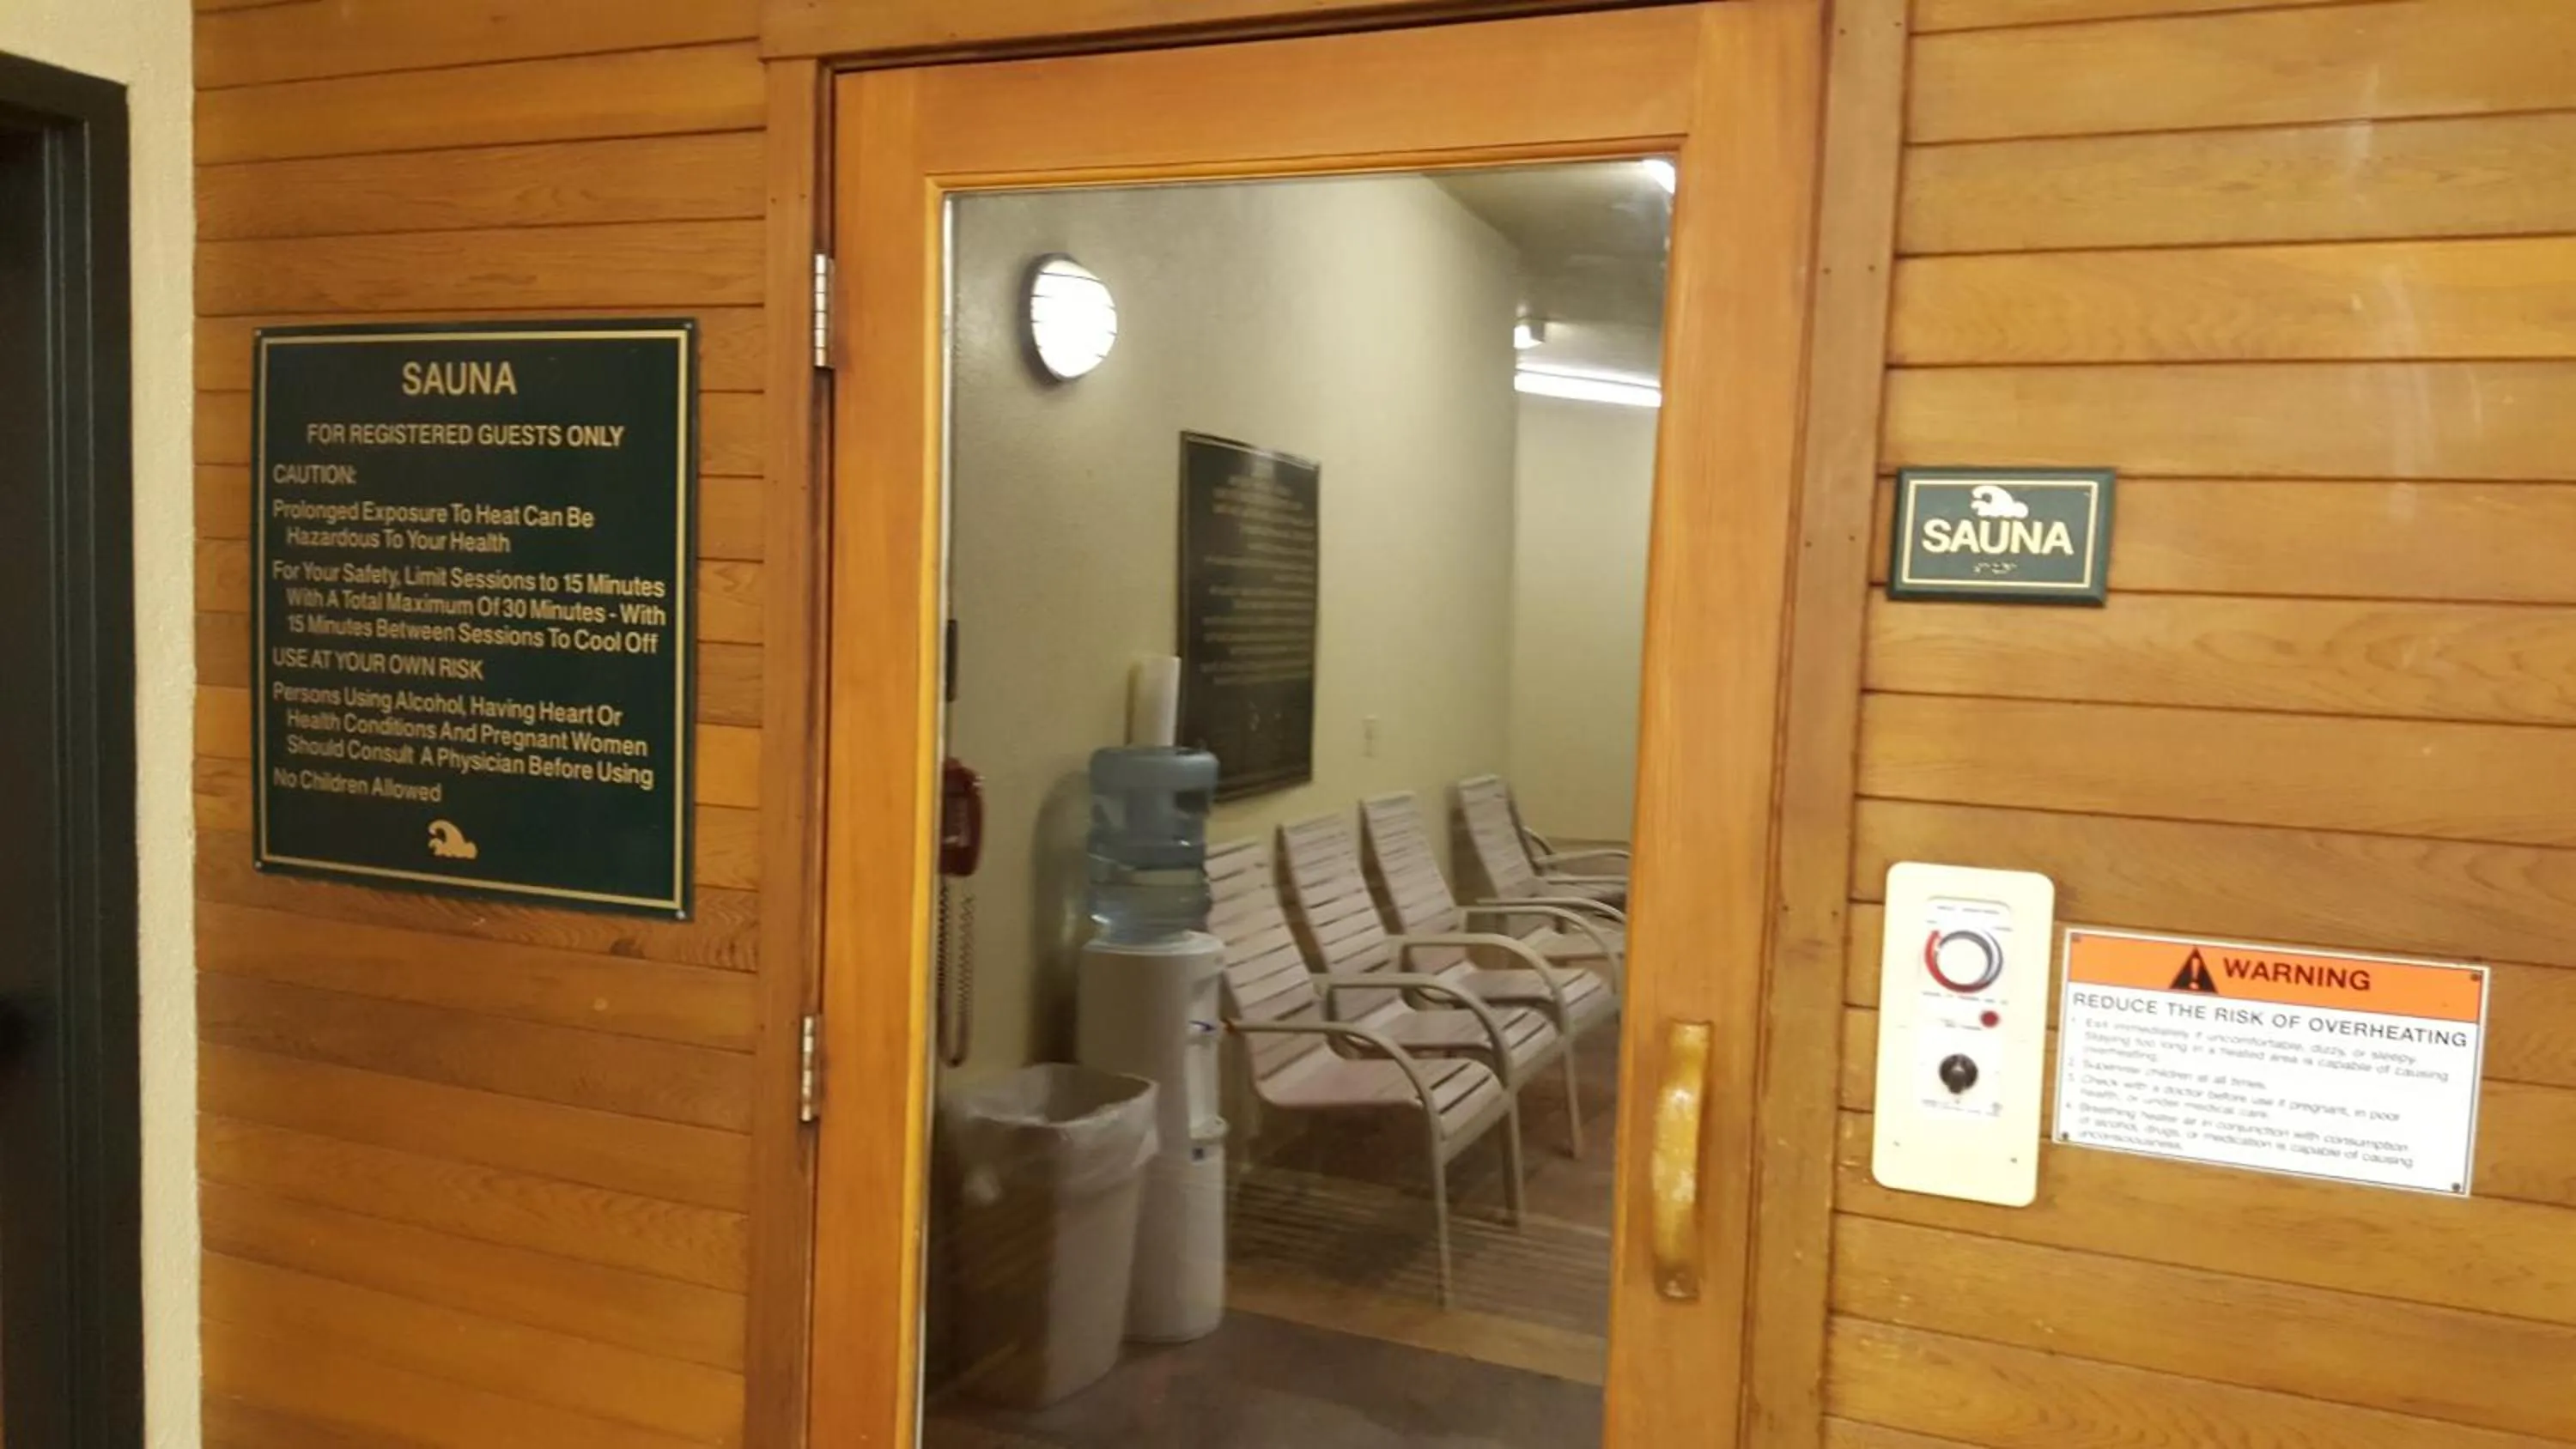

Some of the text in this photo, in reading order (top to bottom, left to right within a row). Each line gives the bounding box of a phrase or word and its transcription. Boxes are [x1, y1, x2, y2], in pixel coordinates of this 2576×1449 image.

[402, 361, 517, 396] SAUNA
[307, 423, 624, 446] FOR REGISTERED GUESTS ONLY
[273, 464, 357, 484] CAUTION:
[273, 499, 594, 528] Prolonged Exposure To Heat Can Be
[287, 526, 511, 553] Hazardous To Your Health
[1922, 518, 2074, 555] SAUNA
[272, 561, 665, 597] For Your Safety, Limit Sessions to 15 Minutes
[286, 587, 324, 607] With
[326, 590, 339, 608] A
[342, 591, 383, 609] Total
[387, 591, 473, 615] Maximum
[477, 596, 501, 616] Of
[502, 599, 526, 618] 30
[530, 600, 605, 622] Minutes
[619, 603, 665, 626] With
[289, 614, 659, 653] 15 Minutes Between Sessions To Cool Off
[272, 647, 484, 680] USE AT YOUR OWN RISK
[273, 682, 623, 726] Persons Using Alcohol, Having Heart Or
[287, 708, 648, 756] Health Conditions And Pregnant Women
[287, 734, 653, 791] Should Consult A Physician Before Using
[273, 767, 441, 802] No Children Allowed
[2224, 957, 2372, 991] WARNING
[2074, 992, 2468, 1047] REDUCE THE RISK OF OVERHEATING
[2270, 1053, 2298, 1064] area
[2318, 1058, 2372, 1072] capable
[2376, 1065, 2390, 1074] of
[2394, 1067, 2449, 1082] causing
[2164, 1086, 2204, 1098] doctor
[2208, 1091, 2246, 1103] before
[2369, 1111, 2400, 1121] poor
[2344, 1151, 2358, 1160] of
[2362, 1153, 2414, 1167] causing
